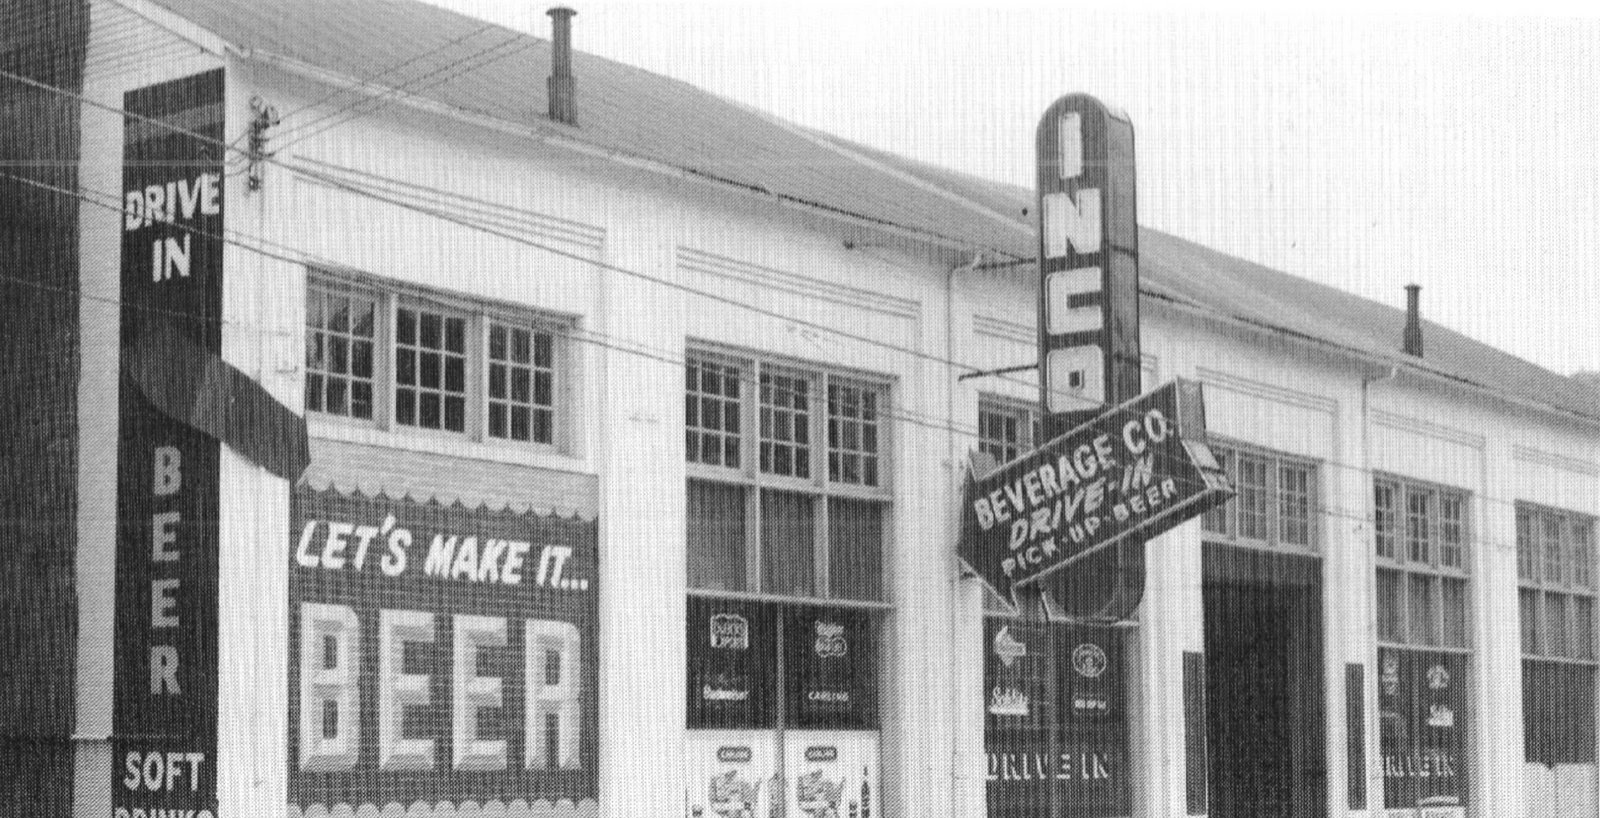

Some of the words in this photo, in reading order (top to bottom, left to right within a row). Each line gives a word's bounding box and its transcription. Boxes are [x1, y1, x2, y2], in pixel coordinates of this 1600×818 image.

[125, 172, 221, 231] DRIVE
[152, 232, 191, 283] IN
[1042, 110, 1105, 414] INCO
[974, 434, 1118, 532] BEVERAGE
[1122, 408, 1174, 455] CO.
[150, 445, 183, 695] BEER
[296, 512, 412, 577] LET'S
[424, 533, 530, 585] MAKE
[536, 544, 589, 591] IT...
[299, 601, 581, 772] BEER
[123, 751, 205, 792] SOFT
